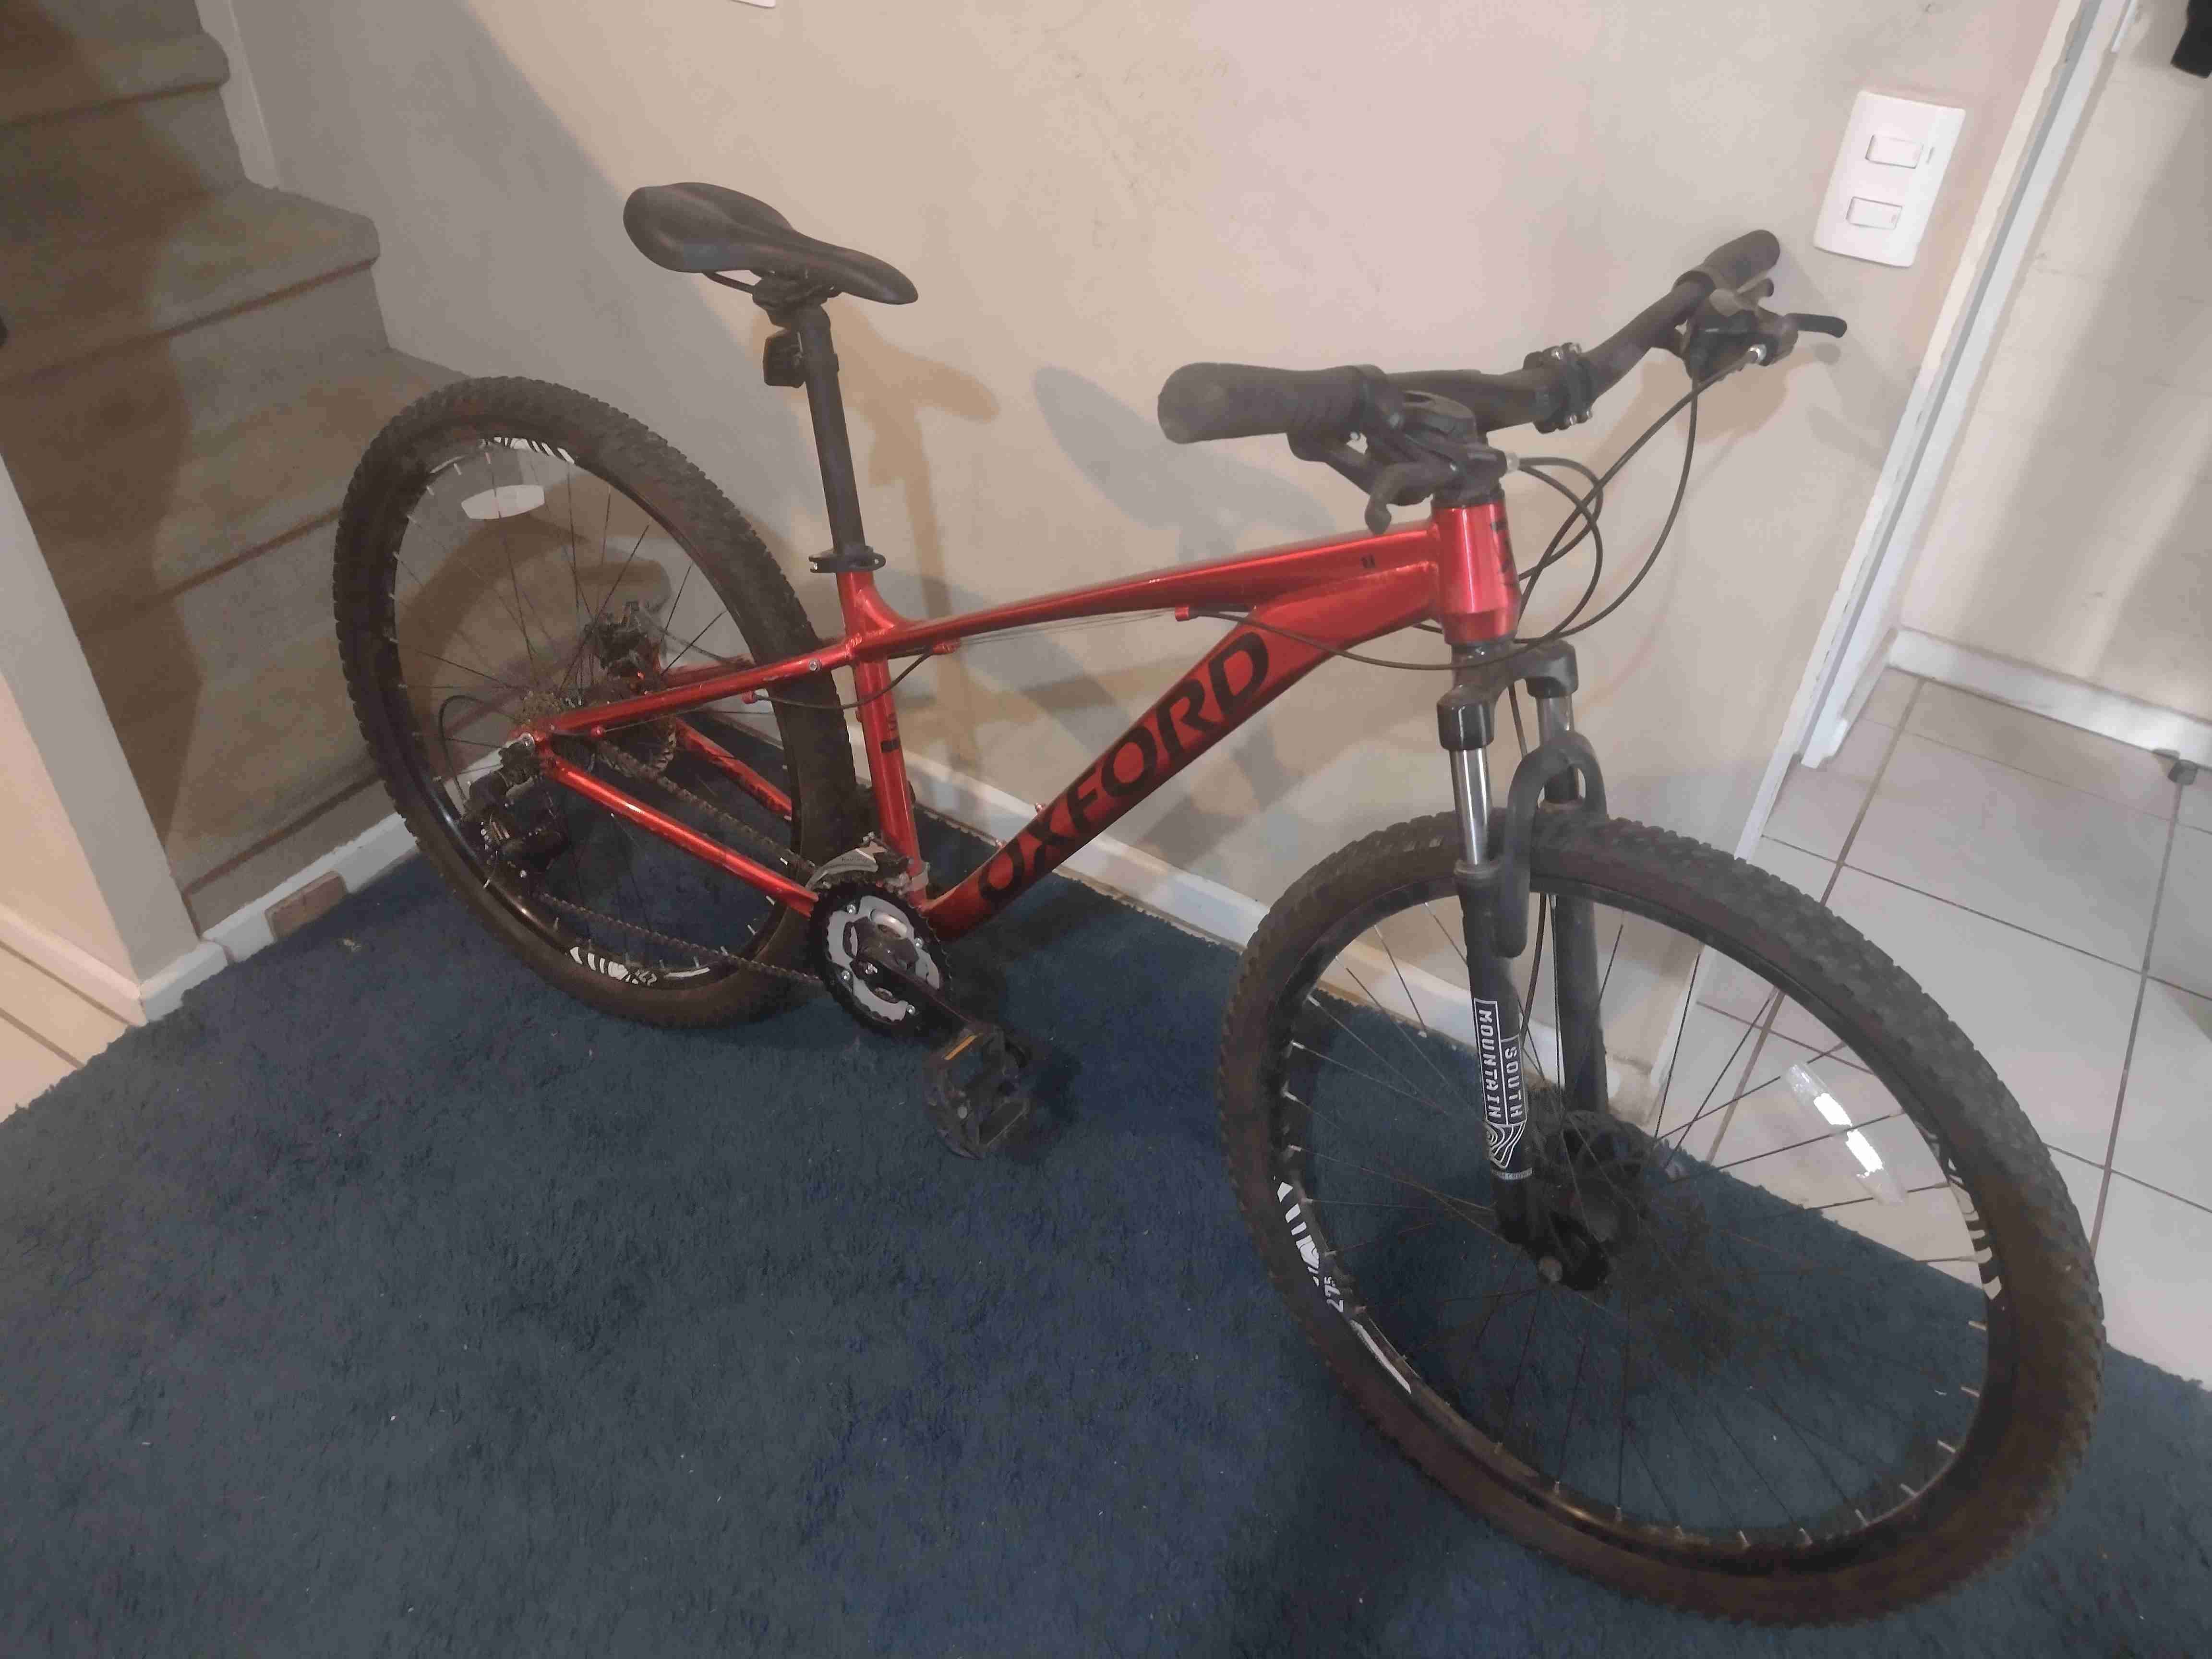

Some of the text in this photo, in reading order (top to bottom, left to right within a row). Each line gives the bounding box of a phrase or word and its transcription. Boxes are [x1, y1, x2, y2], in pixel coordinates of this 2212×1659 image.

[978, 632, 1269, 902] OXFORD
[1479, 1010, 1502, 1118] MOUNTAIN
[1504, 1046, 1522, 1118] SOUTH
